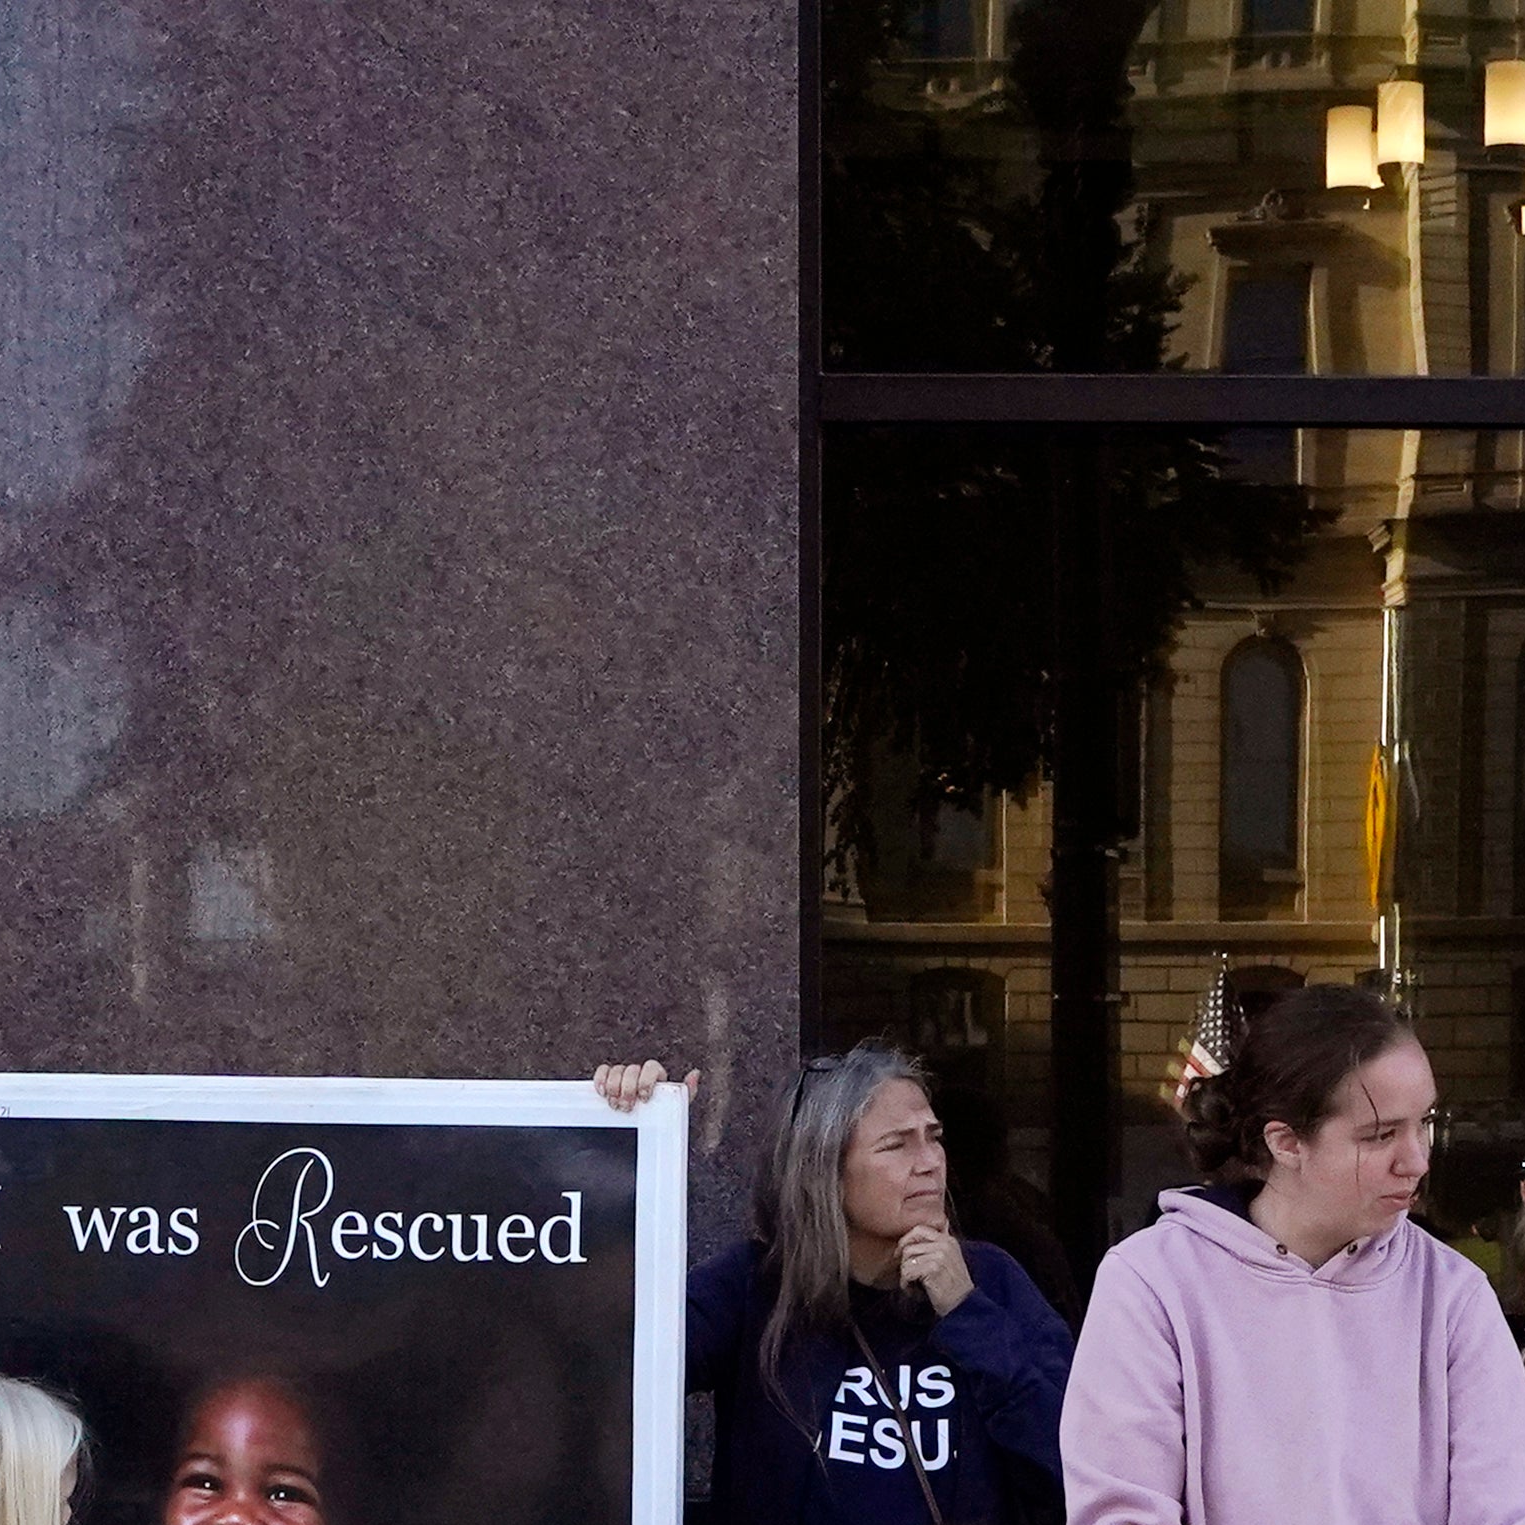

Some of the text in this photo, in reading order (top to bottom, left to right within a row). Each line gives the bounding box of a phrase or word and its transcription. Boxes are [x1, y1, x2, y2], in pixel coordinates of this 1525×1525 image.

[63, 1204, 200, 1257] was
[234, 1147, 588, 1289] Rescued
[813, 1410, 959, 1472] ESU
